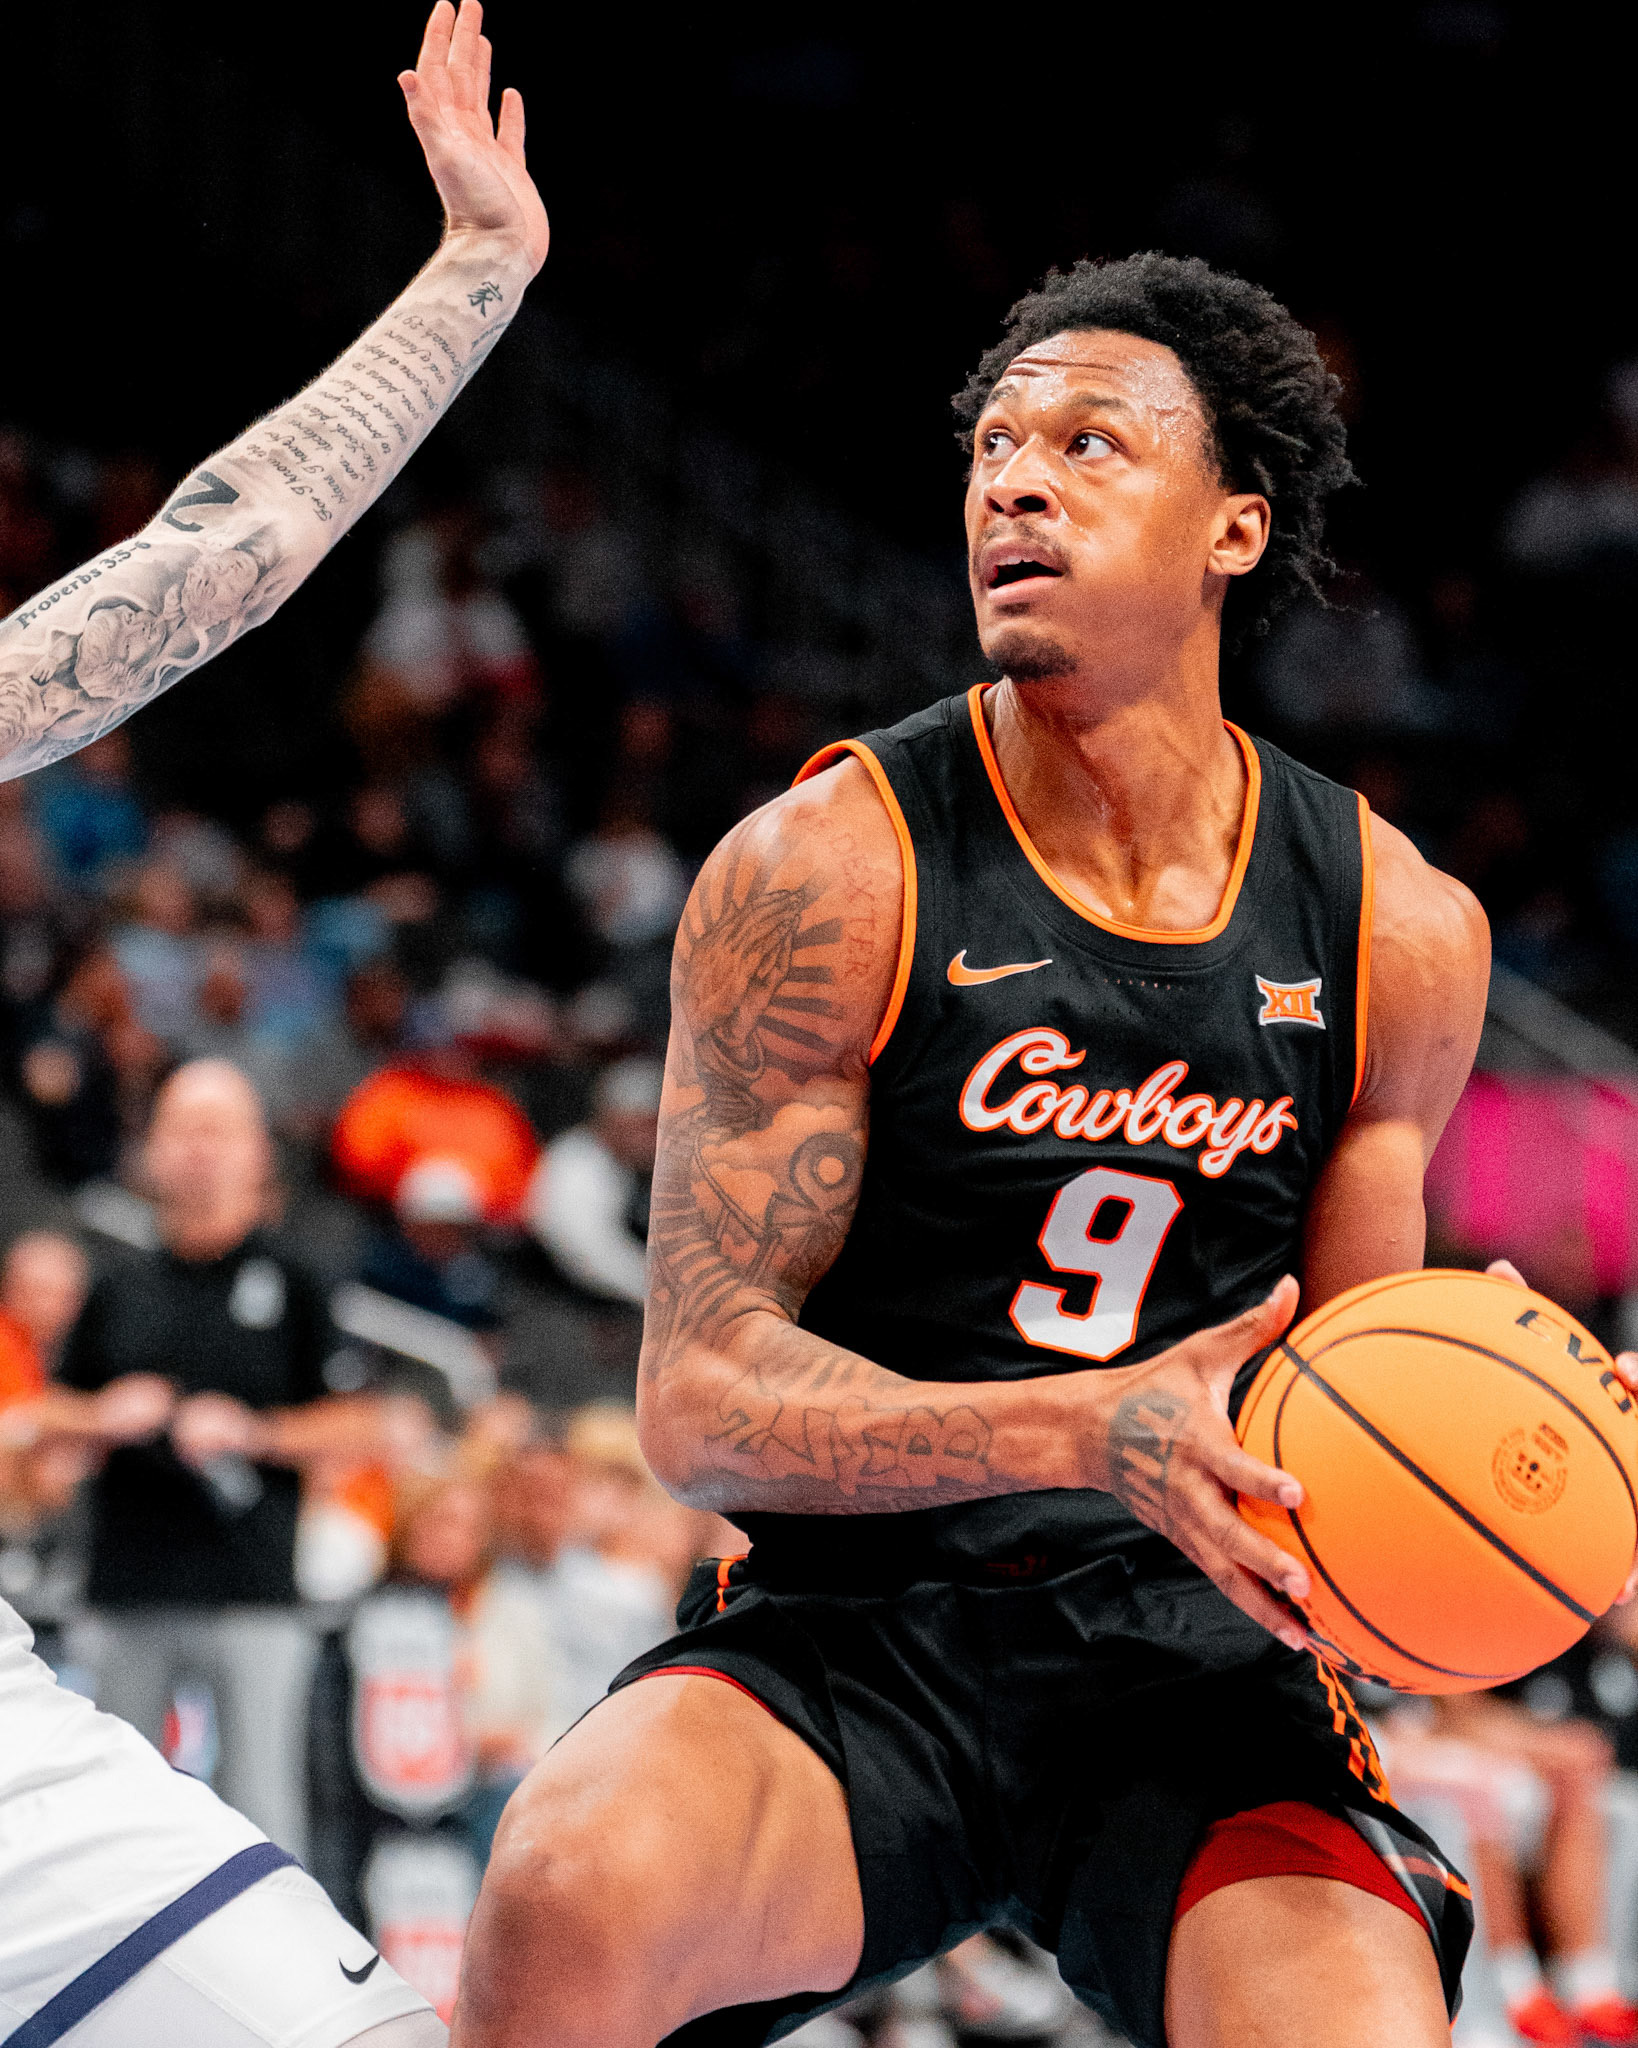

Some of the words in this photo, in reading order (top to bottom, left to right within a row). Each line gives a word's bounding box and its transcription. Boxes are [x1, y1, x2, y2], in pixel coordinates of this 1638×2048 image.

[388, 357, 399, 365] a
[420, 328, 465, 376] Jeremiah
[366, 370, 405, 393] plans
[422, 363, 446, 384] and
[340, 405, 386, 440] prosper
[373, 402, 395, 420] not
[282, 440, 308, 465] have
[381, 442, 391, 454] to
[267, 454, 297, 485] know
[302, 465, 325, 474] I
[362, 453, 378, 472] the
[290, 479, 314, 495] I
[162, 470, 240, 532] 2
[311, 496, 333, 522] For
[16, 568, 102, 629] Proverbs
[100, 542, 152, 569] 3:5-6
[1258, 980, 1322, 1024] XII
[959, 1027, 1298, 1178] Cowboys
[1009, 1166, 1185, 1362] 9
